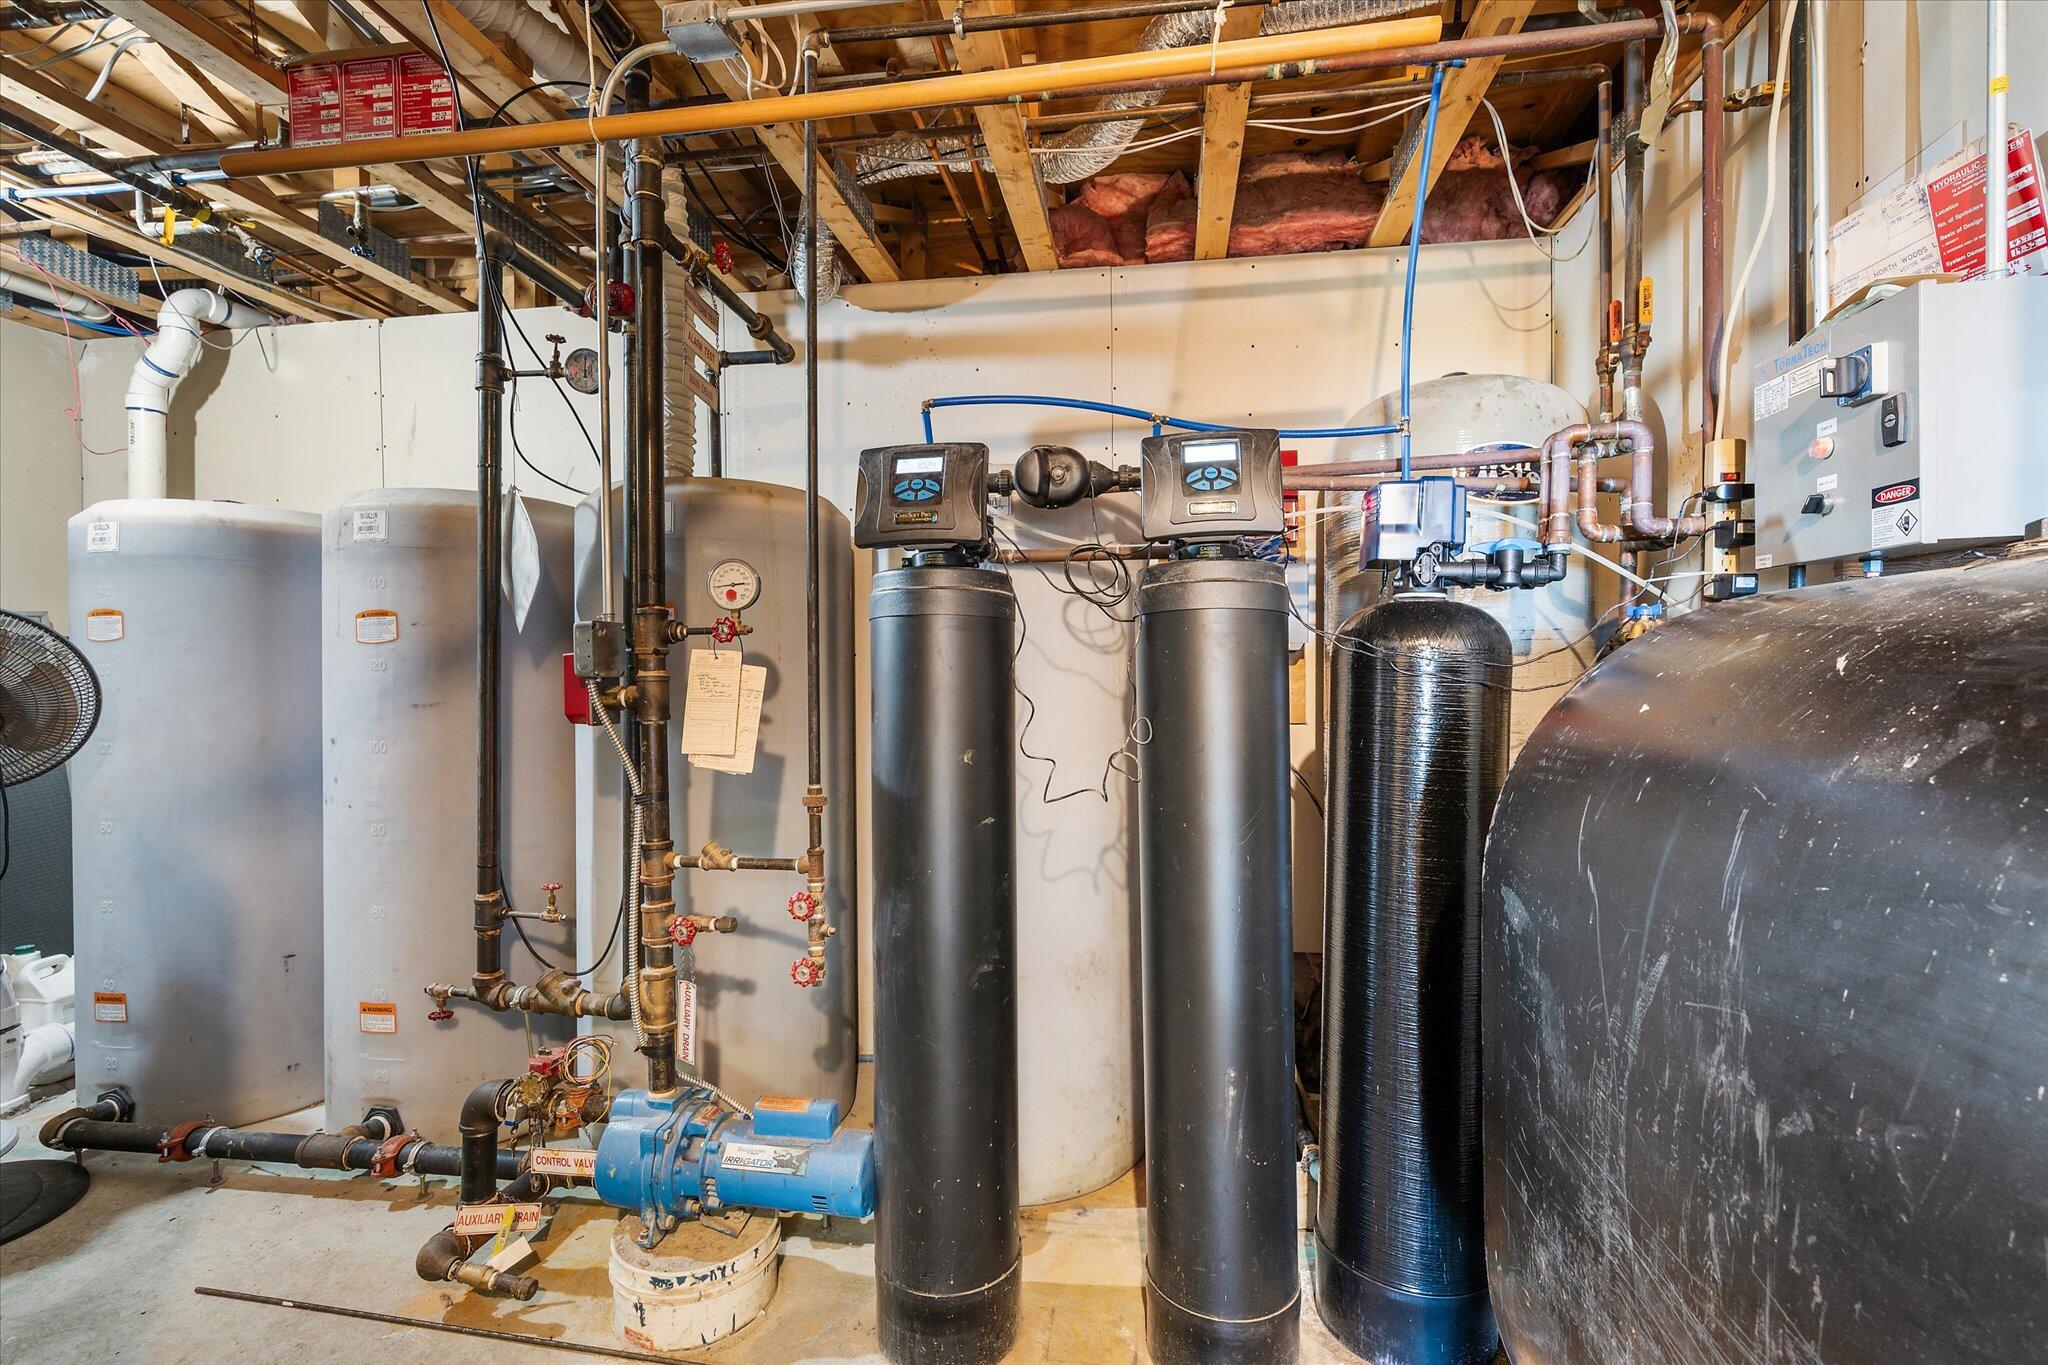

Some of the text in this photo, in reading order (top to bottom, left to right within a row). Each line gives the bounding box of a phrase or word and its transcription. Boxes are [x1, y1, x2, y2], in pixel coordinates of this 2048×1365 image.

[1933, 160, 1981, 191] HYDRAULIC
[1935, 201, 1959, 216] Location
[1937, 220, 1945, 228] No.
[1955, 203, 1983, 220] Sprinklers
[1963, 217, 1983, 229] Design
[1873, 262, 1898, 278] NORTH
[1900, 247, 1928, 264] WOODS
[1945, 245, 1986, 266] System Deman
[688, 330, 715, 364] ALARM TEST
[1880, 487, 1911, 501] DANGER
[370, 740, 387, 753] 100
[682, 982, 692, 1061] AUXILIARY DRAIN
[105, 1057, 119, 1070] 20
[535, 1154, 572, 1168] CONTROL
